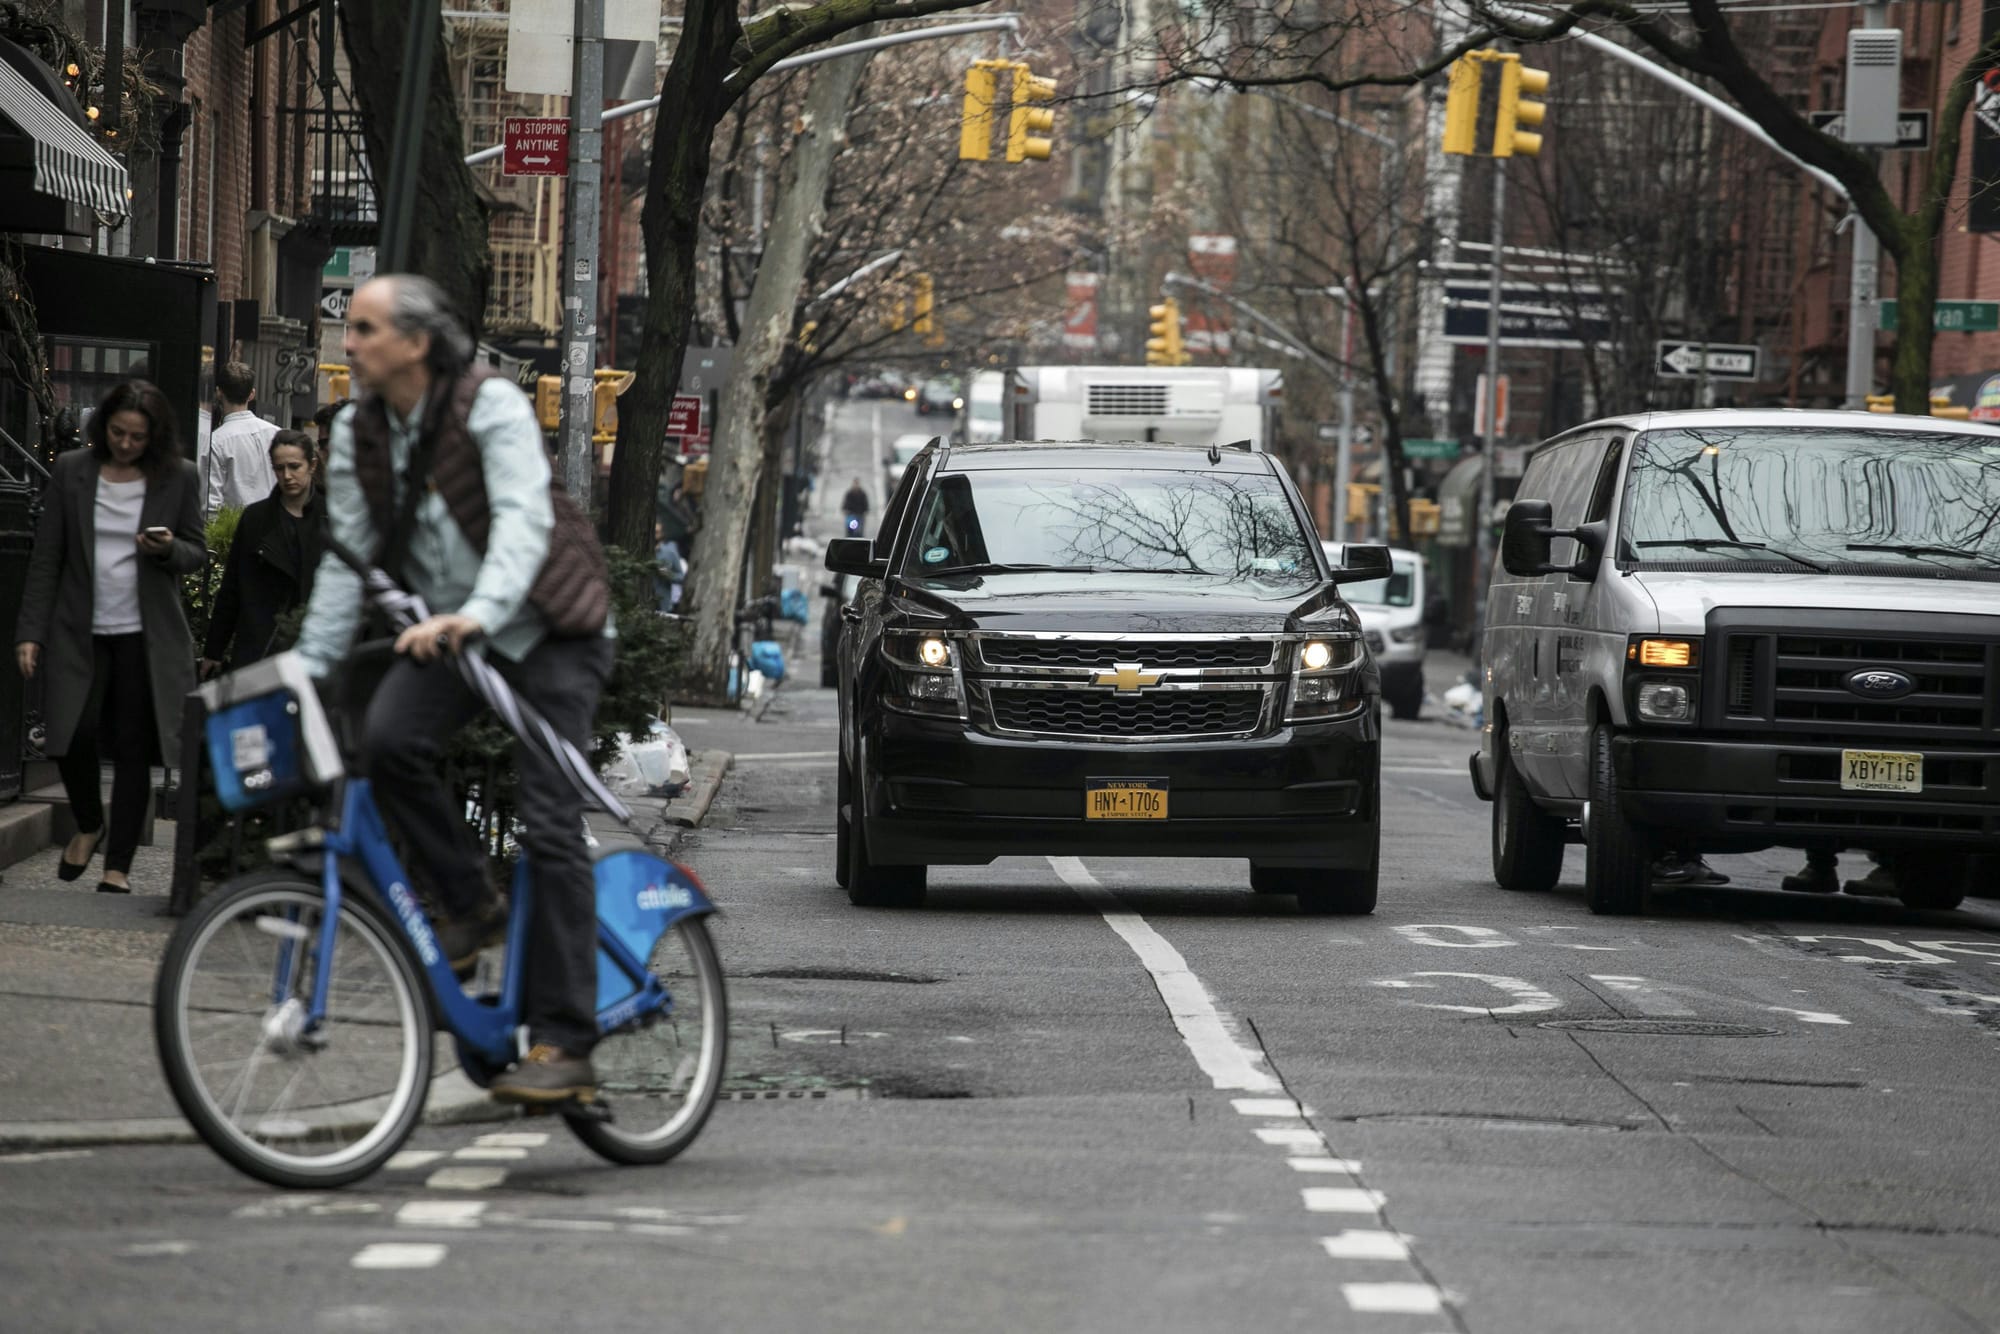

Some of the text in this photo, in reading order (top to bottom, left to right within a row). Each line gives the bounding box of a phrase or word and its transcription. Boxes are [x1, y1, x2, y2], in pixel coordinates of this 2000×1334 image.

[509, 123, 567, 135] NO STOPPING
[515, 139, 559, 151] ANYTIME
[328, 295, 349, 310] ON
[1864, 674, 1898, 689] Ford
[1849, 760, 1879, 780] XBY
[1095, 792, 1160, 811] HNY 1706
